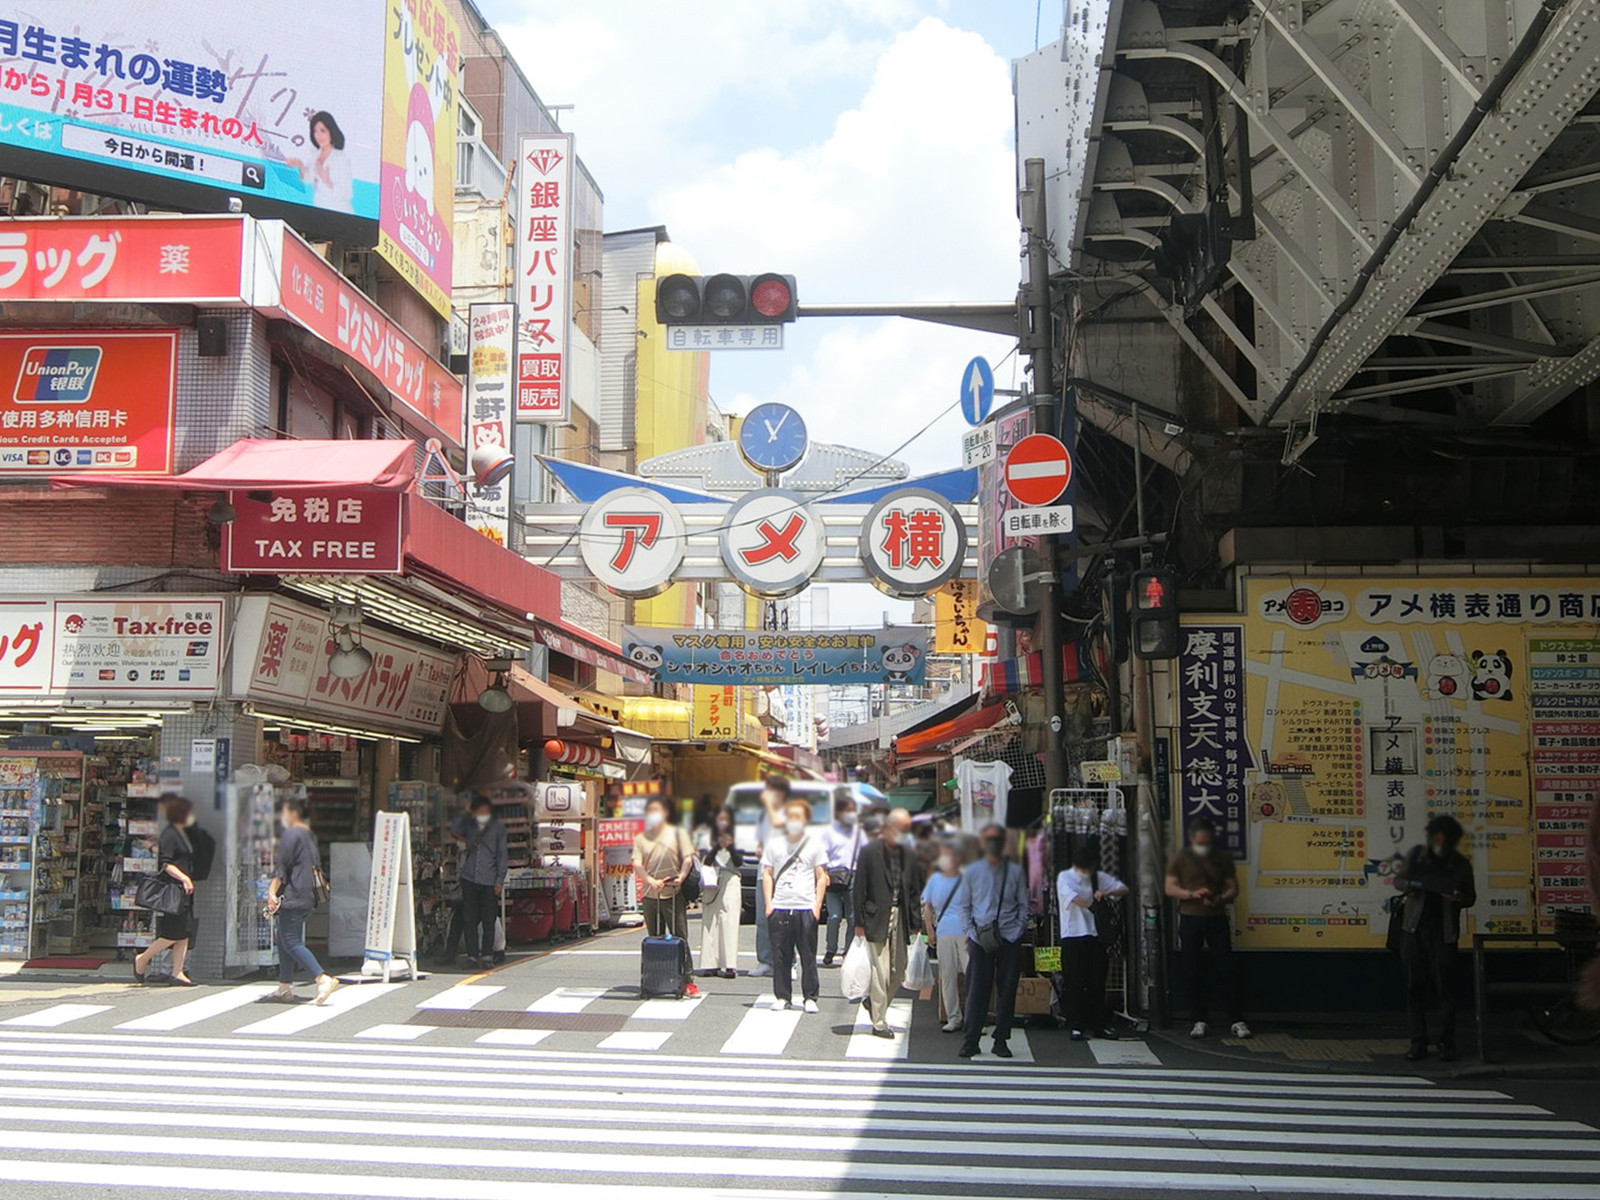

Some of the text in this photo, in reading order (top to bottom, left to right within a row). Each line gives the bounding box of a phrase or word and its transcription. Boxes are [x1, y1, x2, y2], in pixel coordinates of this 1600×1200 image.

[0, 19, 228, 104] 月生まれの運勢
[0, 63, 264, 146] から1月31日生まれの人
[161, 244, 190, 276] 薬
[526, 181, 563, 343] 銀座パリス
[292, 264, 325, 314] 化粧品
[338, 292, 425, 402] コクミンドラッグ
[672, 328, 778, 346] 自転車専用
[26, 361, 93, 379] UnionPay
[522, 360, 560, 377] 買取
[50, 377, 86, 391] 银联
[520, 389, 559, 406] 販売
[21, 435, 50, 444] Credit
[52, 435, 80, 444] Cards
[82, 435, 127, 445] Accepted
[2, 453, 23, 462] VISA
[270, 496, 362, 523] 免税店
[1009, 512, 1067, 532] 自転車を除く
[256, 540, 376, 559] TAX FREE
[604, 510, 945, 574] アメ横
[113, 616, 213, 636] Tax-free
[259, 621, 289, 678] 薬
[719, 650, 814, 661] 命名おめでとう
[666, 660, 881, 675] シャオシャオちゃん レイレイちゃん
[1183, 630, 1222, 750] 摩利支天
[709, 694, 720, 727] プラザ
[1385, 716, 1406, 843] アメ横表通り
